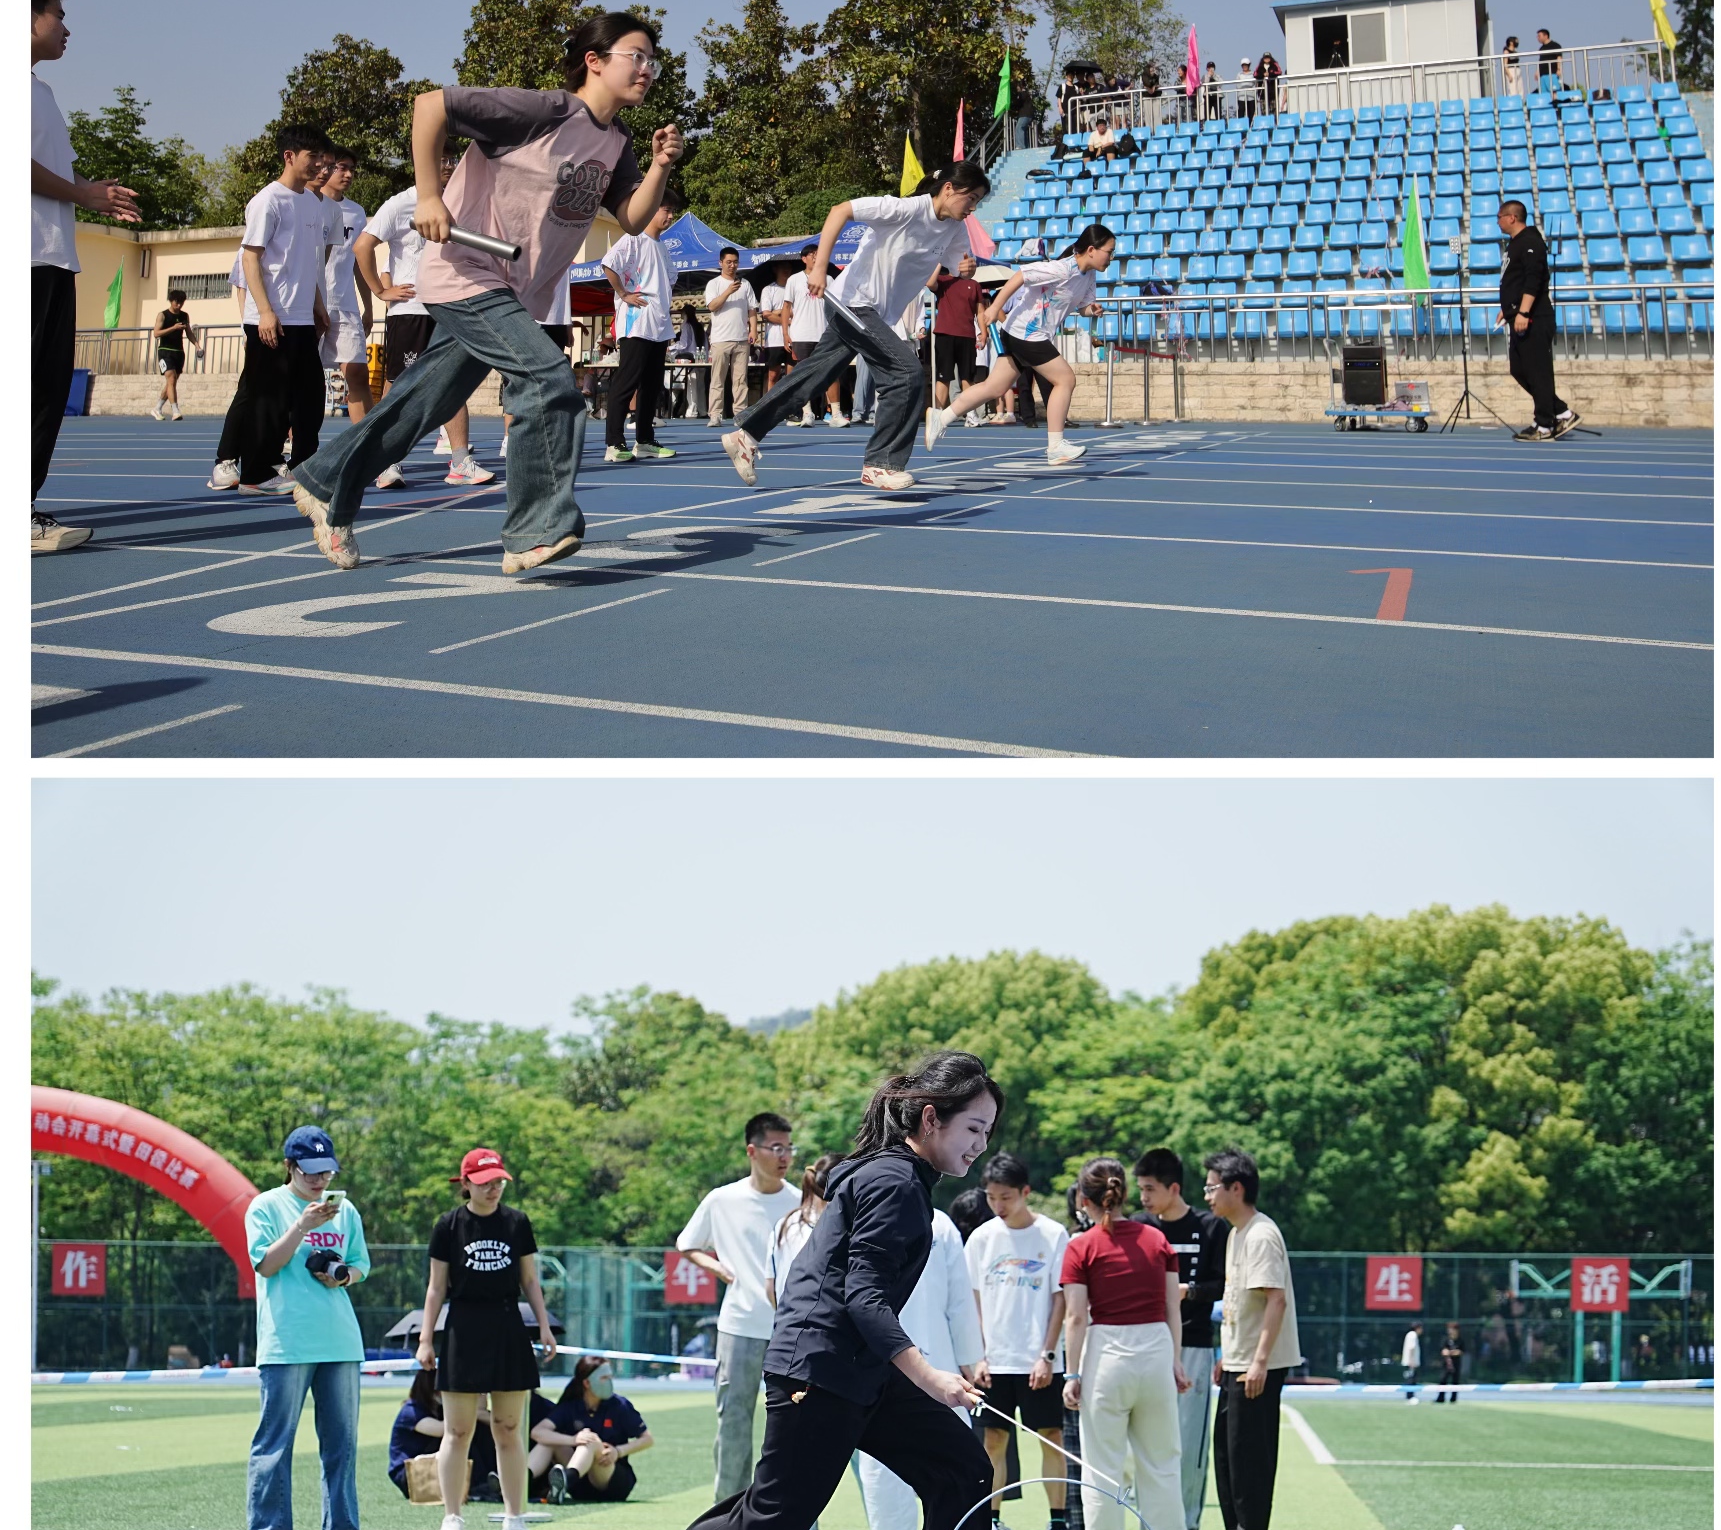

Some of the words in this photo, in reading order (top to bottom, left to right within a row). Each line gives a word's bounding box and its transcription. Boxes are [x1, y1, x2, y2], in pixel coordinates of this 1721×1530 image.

[463, 1239, 511, 1256] BROOKLYN
[474, 1250, 503, 1260] PARLE
[60, 1250, 98, 1288] 作
[671, 1257, 710, 1296] 年
[1374, 1263, 1414, 1302] 生
[1579, 1264, 1621, 1305] 活
